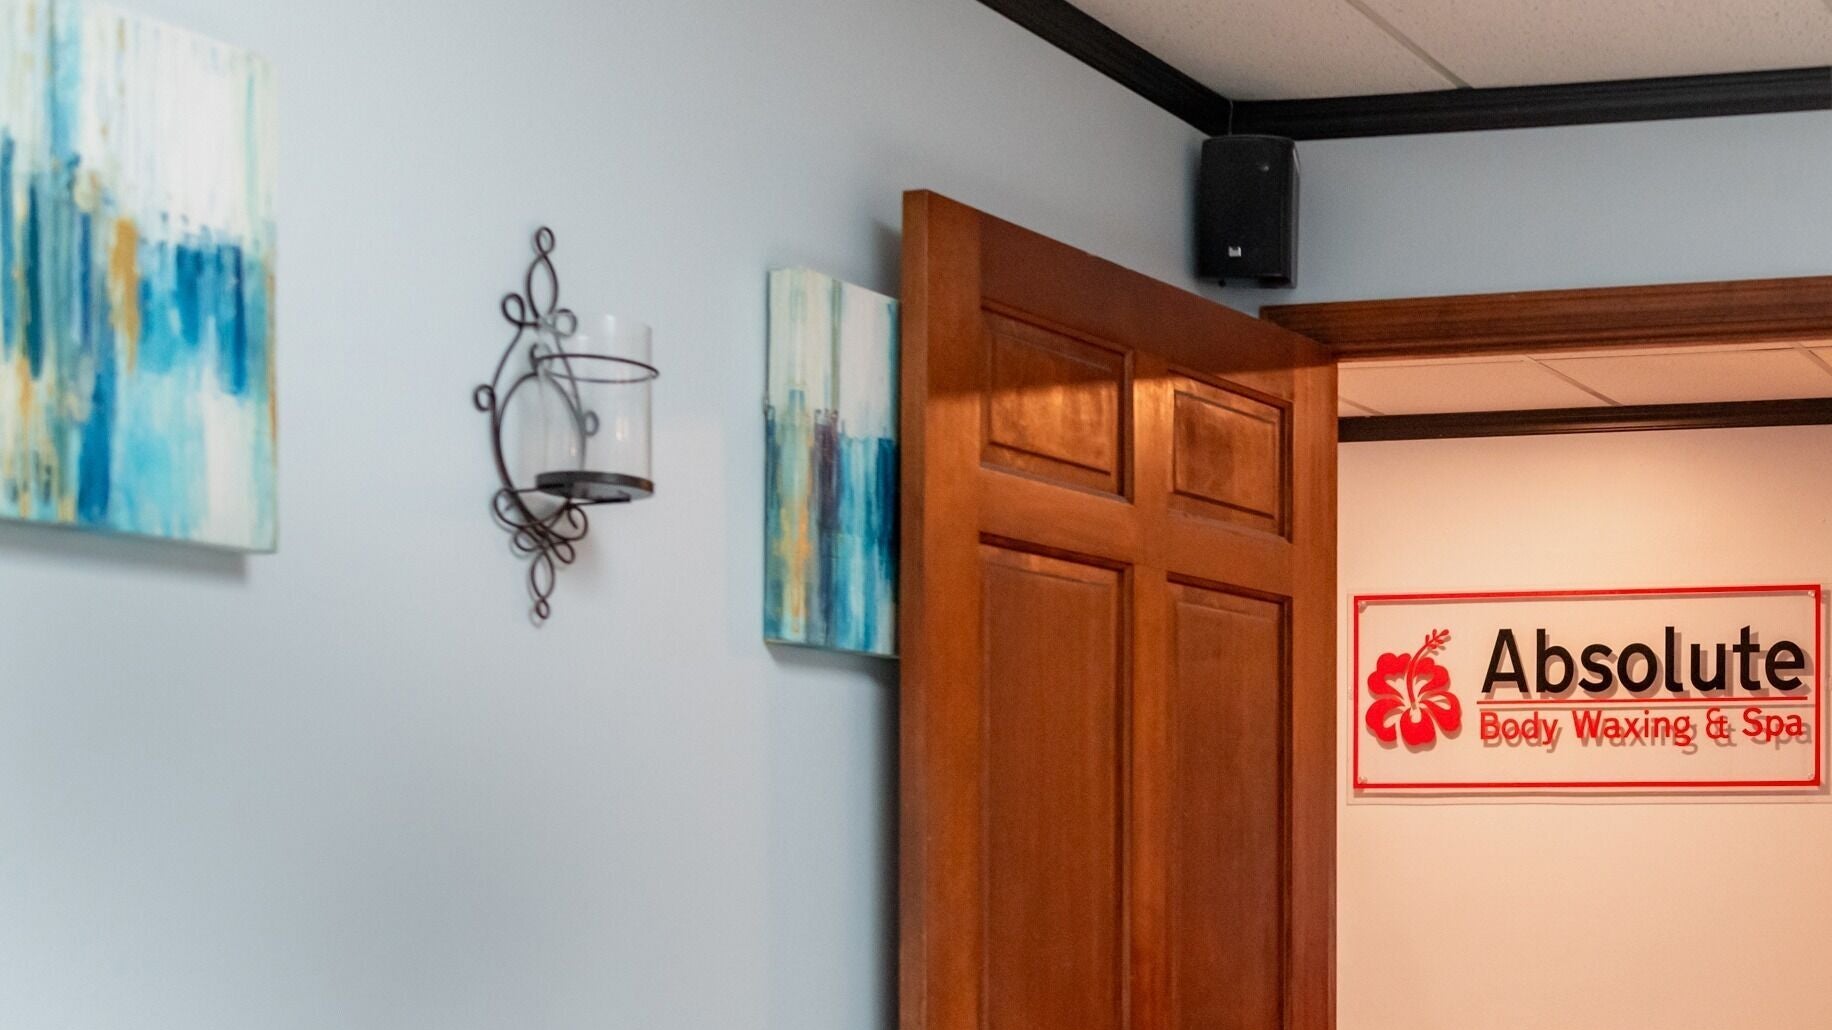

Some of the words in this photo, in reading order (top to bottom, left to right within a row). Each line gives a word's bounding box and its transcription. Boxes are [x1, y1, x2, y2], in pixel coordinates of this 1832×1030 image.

[1481, 624, 1806, 693] Absolute
[1480, 710, 1558, 745] Body
[1571, 708, 1691, 747] Waxing
[1706, 706, 1730, 739] &
[1742, 706, 1804, 742] Spa
